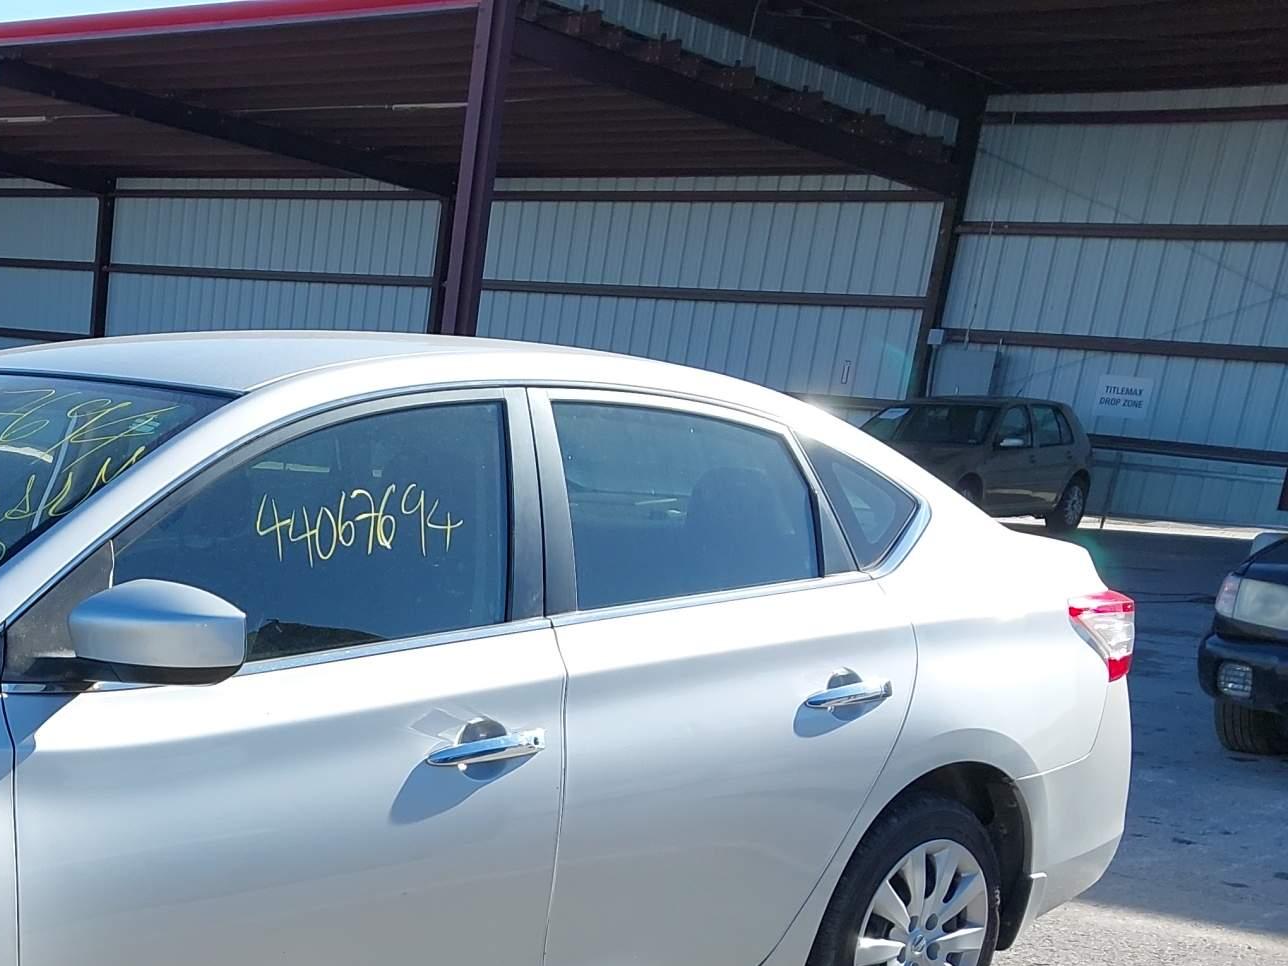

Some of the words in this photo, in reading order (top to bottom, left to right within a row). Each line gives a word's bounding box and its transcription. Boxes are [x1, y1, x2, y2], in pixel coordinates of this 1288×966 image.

[1104, 385, 1144, 396] TITLEMAX
[1099, 396, 1120, 406] DROP
[1122, 399, 1144, 408] ZONE
[256, 483, 464, 568] 44067694
